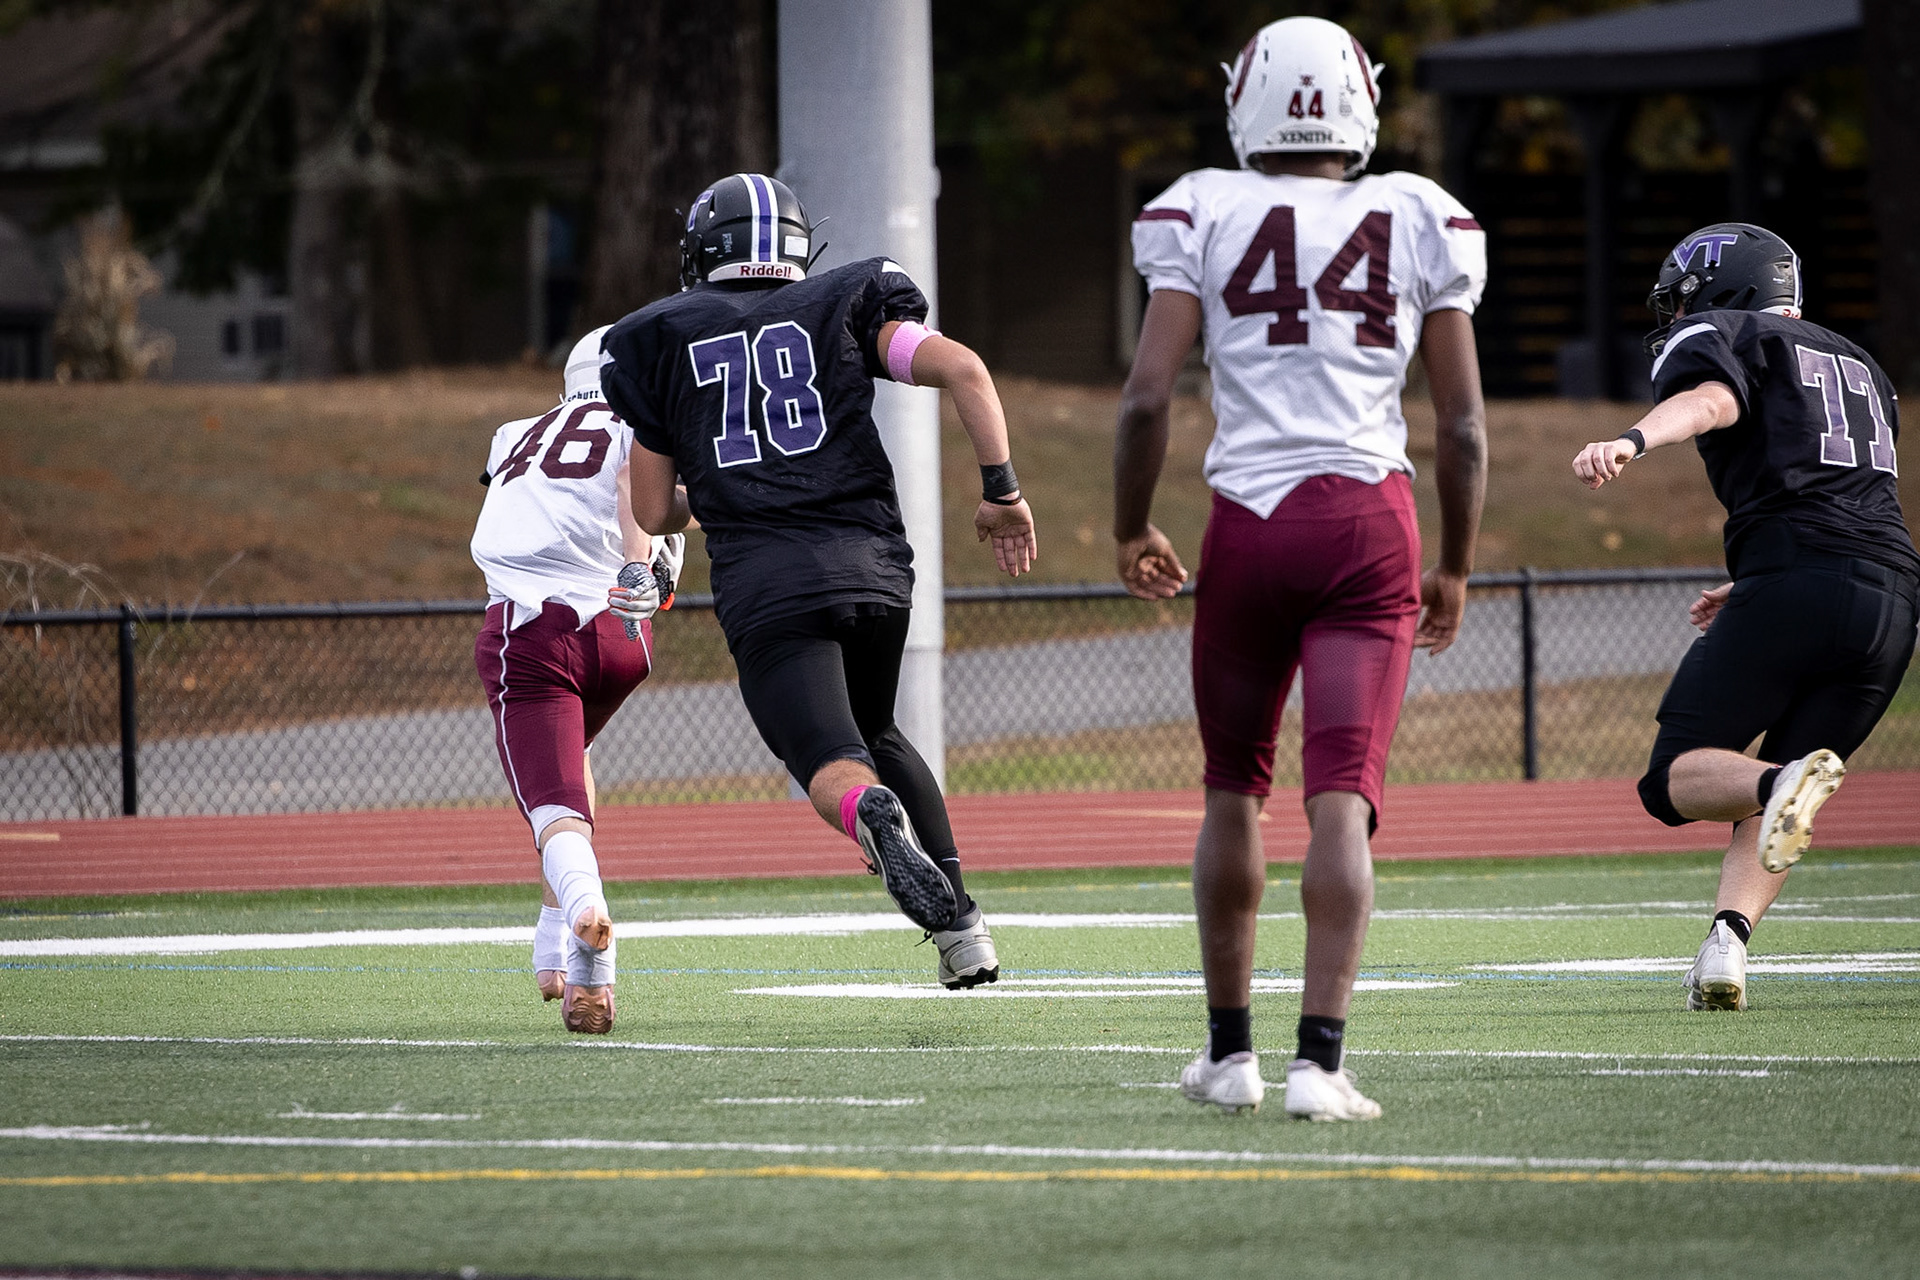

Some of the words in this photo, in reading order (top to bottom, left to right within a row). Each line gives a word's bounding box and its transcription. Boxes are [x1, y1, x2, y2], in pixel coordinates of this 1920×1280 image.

[1288, 88, 1325, 119] 44
[1279, 131, 1333, 144] XENITH
[740, 265, 792, 278] Riddell
[1222, 206, 1397, 349] 44
[1673, 234, 1738, 273] VT
[688, 321, 828, 469] 78
[1795, 344, 1899, 478] 77
[492, 401, 621, 487] 46
